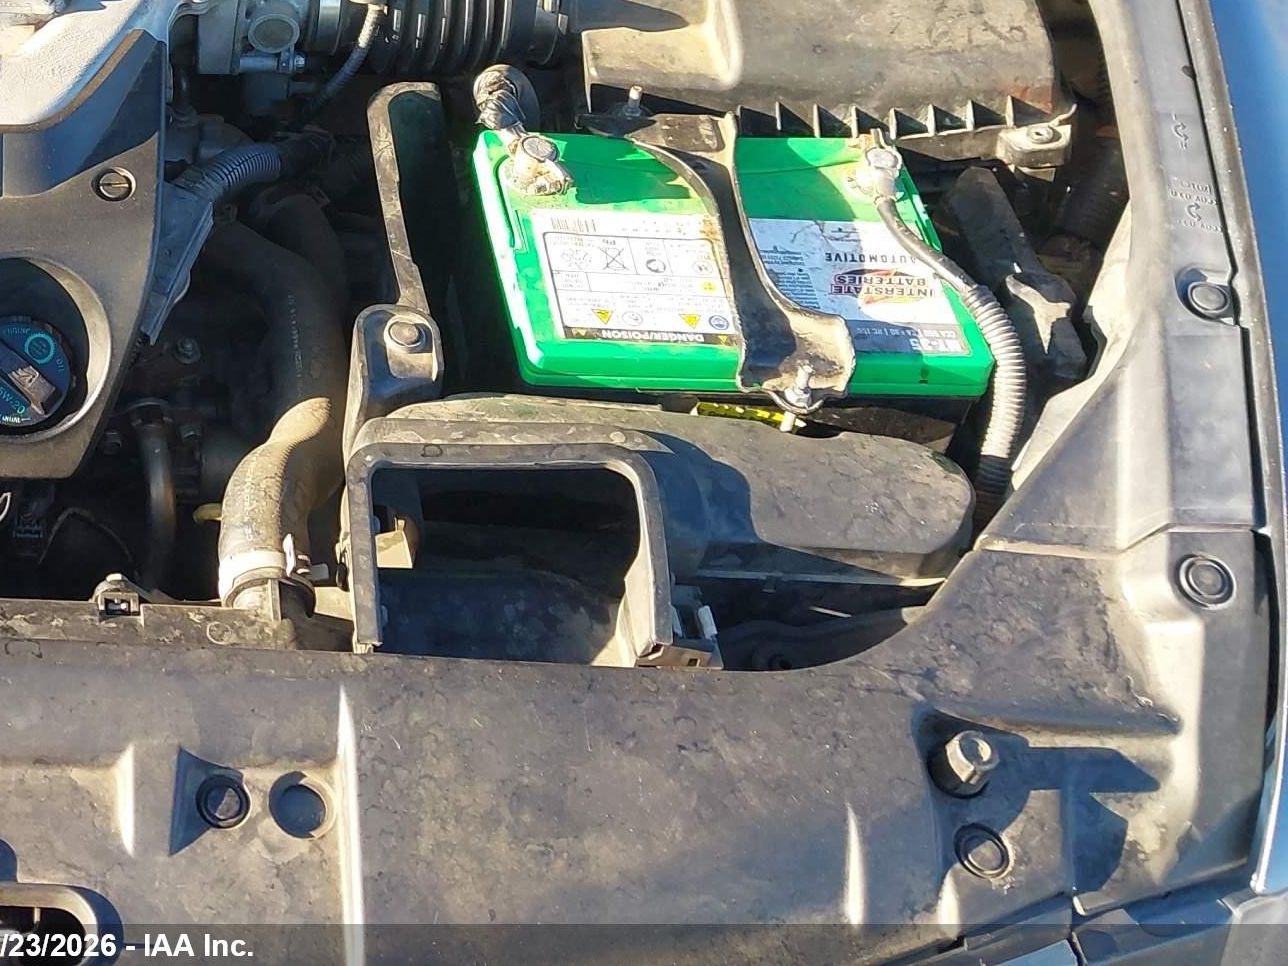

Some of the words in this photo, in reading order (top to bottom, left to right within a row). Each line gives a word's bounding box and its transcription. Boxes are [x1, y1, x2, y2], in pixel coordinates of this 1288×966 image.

[825, 252, 916, 264] AUTOMOTIVE
[835, 274, 926, 286] BATTERIES
[832, 285, 934, 297] INTERSTATE
[602, 329, 705, 343] DANGER/POISON
